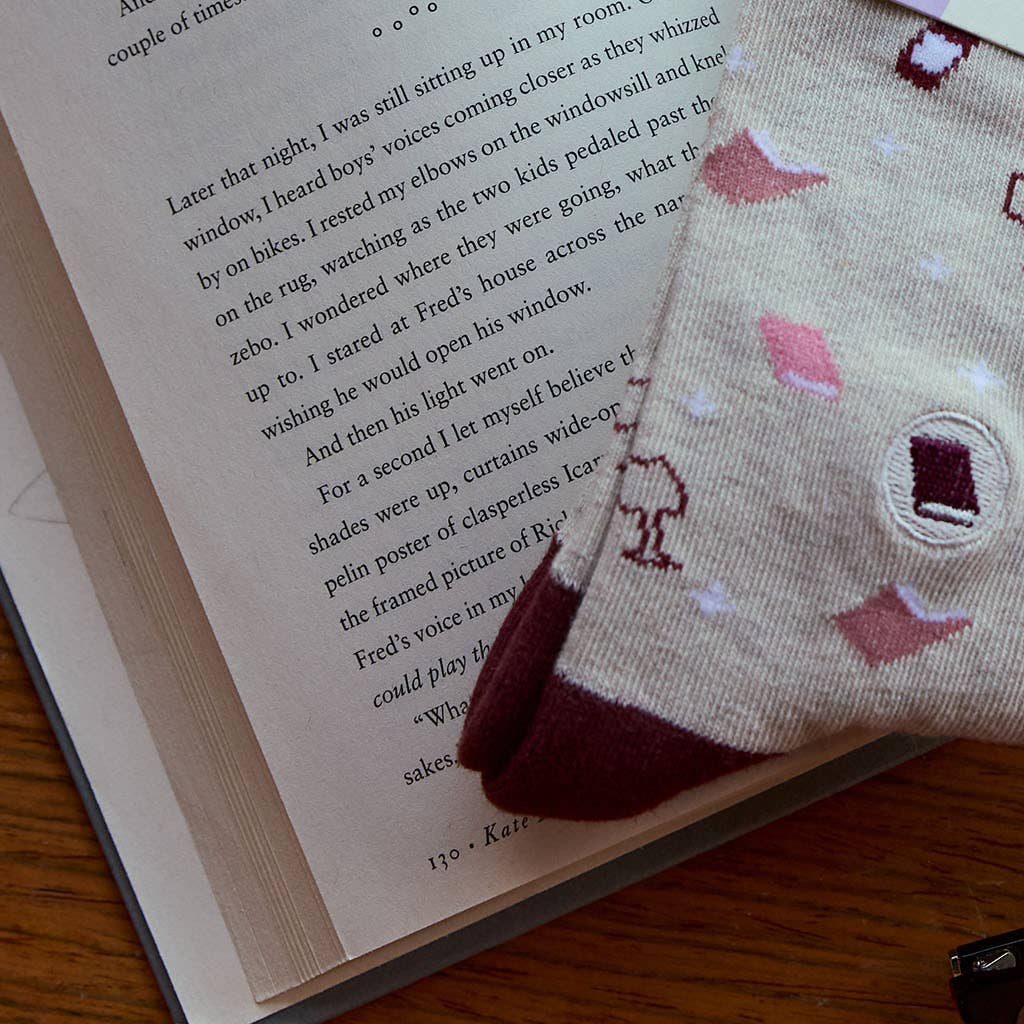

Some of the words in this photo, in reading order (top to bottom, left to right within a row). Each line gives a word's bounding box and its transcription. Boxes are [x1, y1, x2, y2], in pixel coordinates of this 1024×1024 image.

[166, 183, 216, 215] Later
[220, 163, 259, 189] that
[261, 138, 316, 170] night,
[316, 123, 329, 142] I
[332, 109, 369, 133] was
[375, 84, 410, 115] still
[415, 61, 476, 97] sitting
[479, 49, 505, 68] up
[509, 37, 532, 54] in
[536, 22, 565, 44] my
[573, 1, 631, 29] room.
[183, 209, 262, 251] window,
[260, 195, 273, 214] I
[272, 169, 328, 209] heard
[382, 122, 440, 155] voices
[444, 88, 517, 128] coming
[519, 63, 575, 94] closer
[581, 53, 601, 70] as
[604, 36, 643, 60] they
[648, 6, 720, 43] whizzed
[307, 433, 344, 467] And
[345, 419, 389, 446] then
[389, 402, 420, 425] his
[421, 381, 467, 411] light
[470, 357, 518, 387] went
[523, 345, 554, 363] on.
[324, 563, 371, 598] pelin
[374, 534, 431, 575] poster
[438, 515, 458, 540] of
[463, 476, 560, 529] clasperless
[340, 609, 370, 631] the
[372, 571, 439, 617] framed
[441, 547, 506, 591] picture
[510, 528, 531, 553] of
[483, 808, 528, 846] Kate
